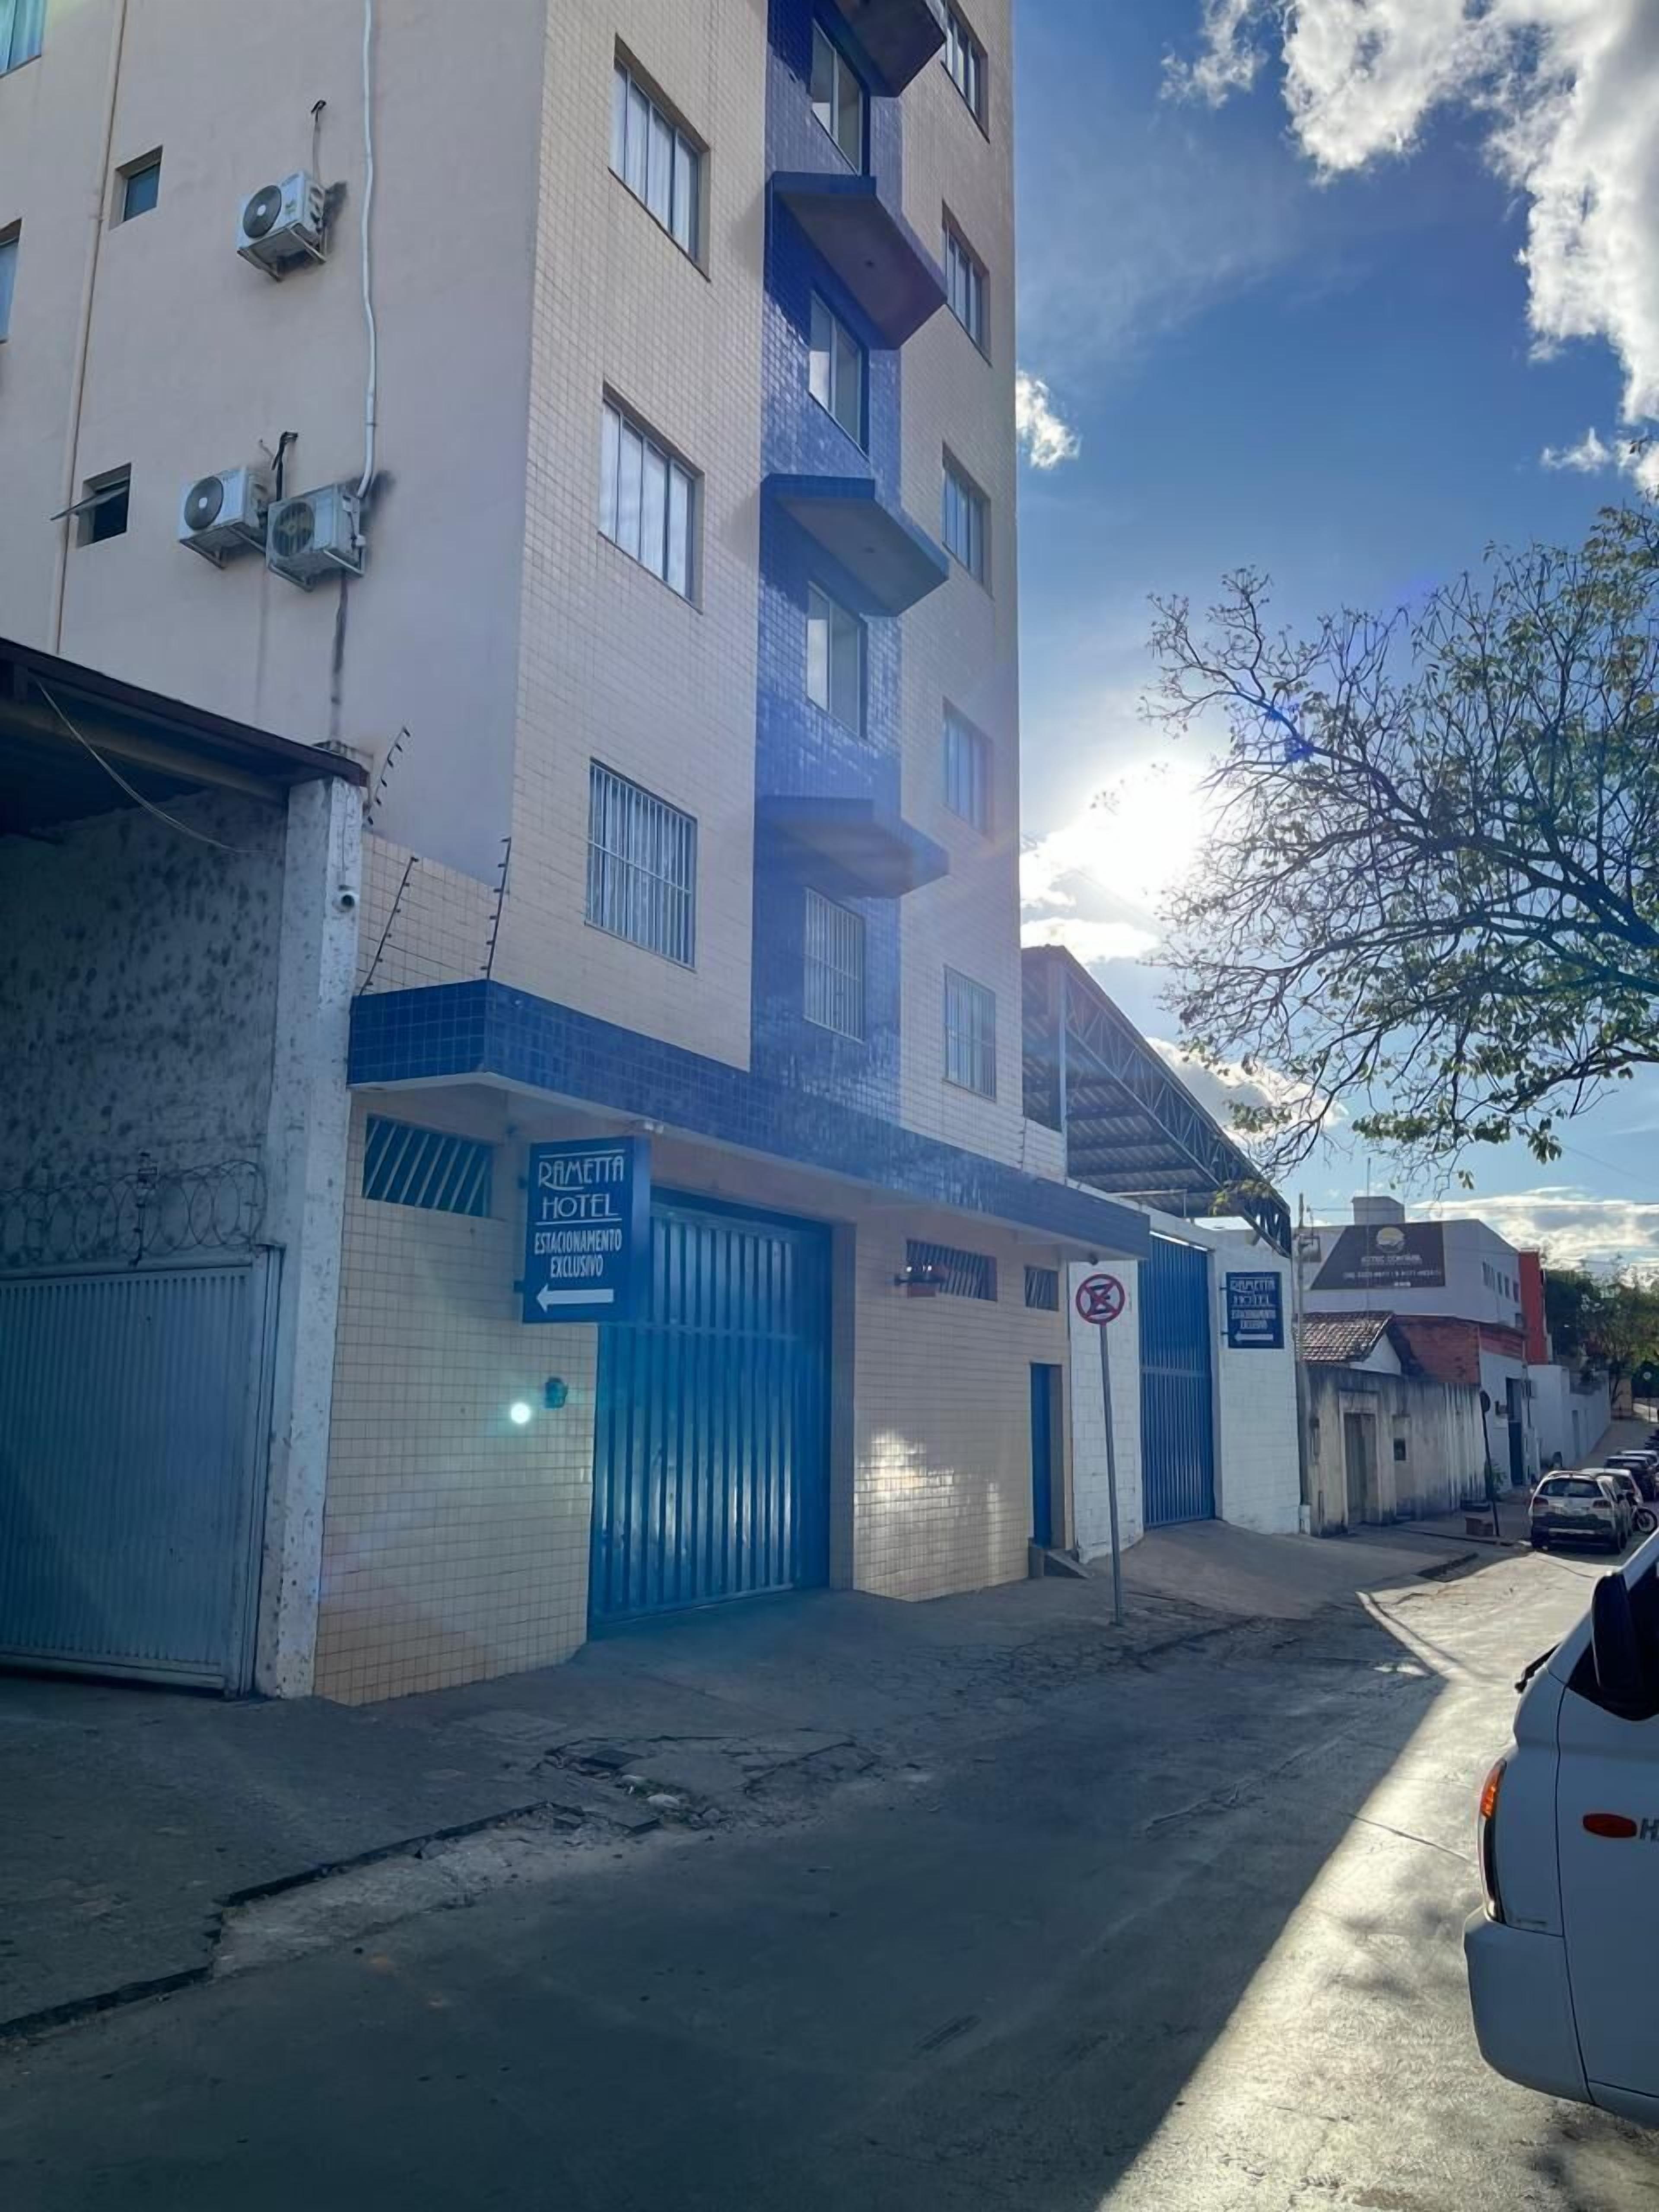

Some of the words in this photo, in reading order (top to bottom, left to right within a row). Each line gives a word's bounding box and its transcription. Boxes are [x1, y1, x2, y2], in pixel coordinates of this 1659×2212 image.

[538, 1156, 624, 1191] RAMETTA
[543, 1193, 619, 1220] HOTEL
[534, 1229, 622, 1254] ESTACIONAMENTO
[551, 1254, 603, 1278] EXCLUSIVO
